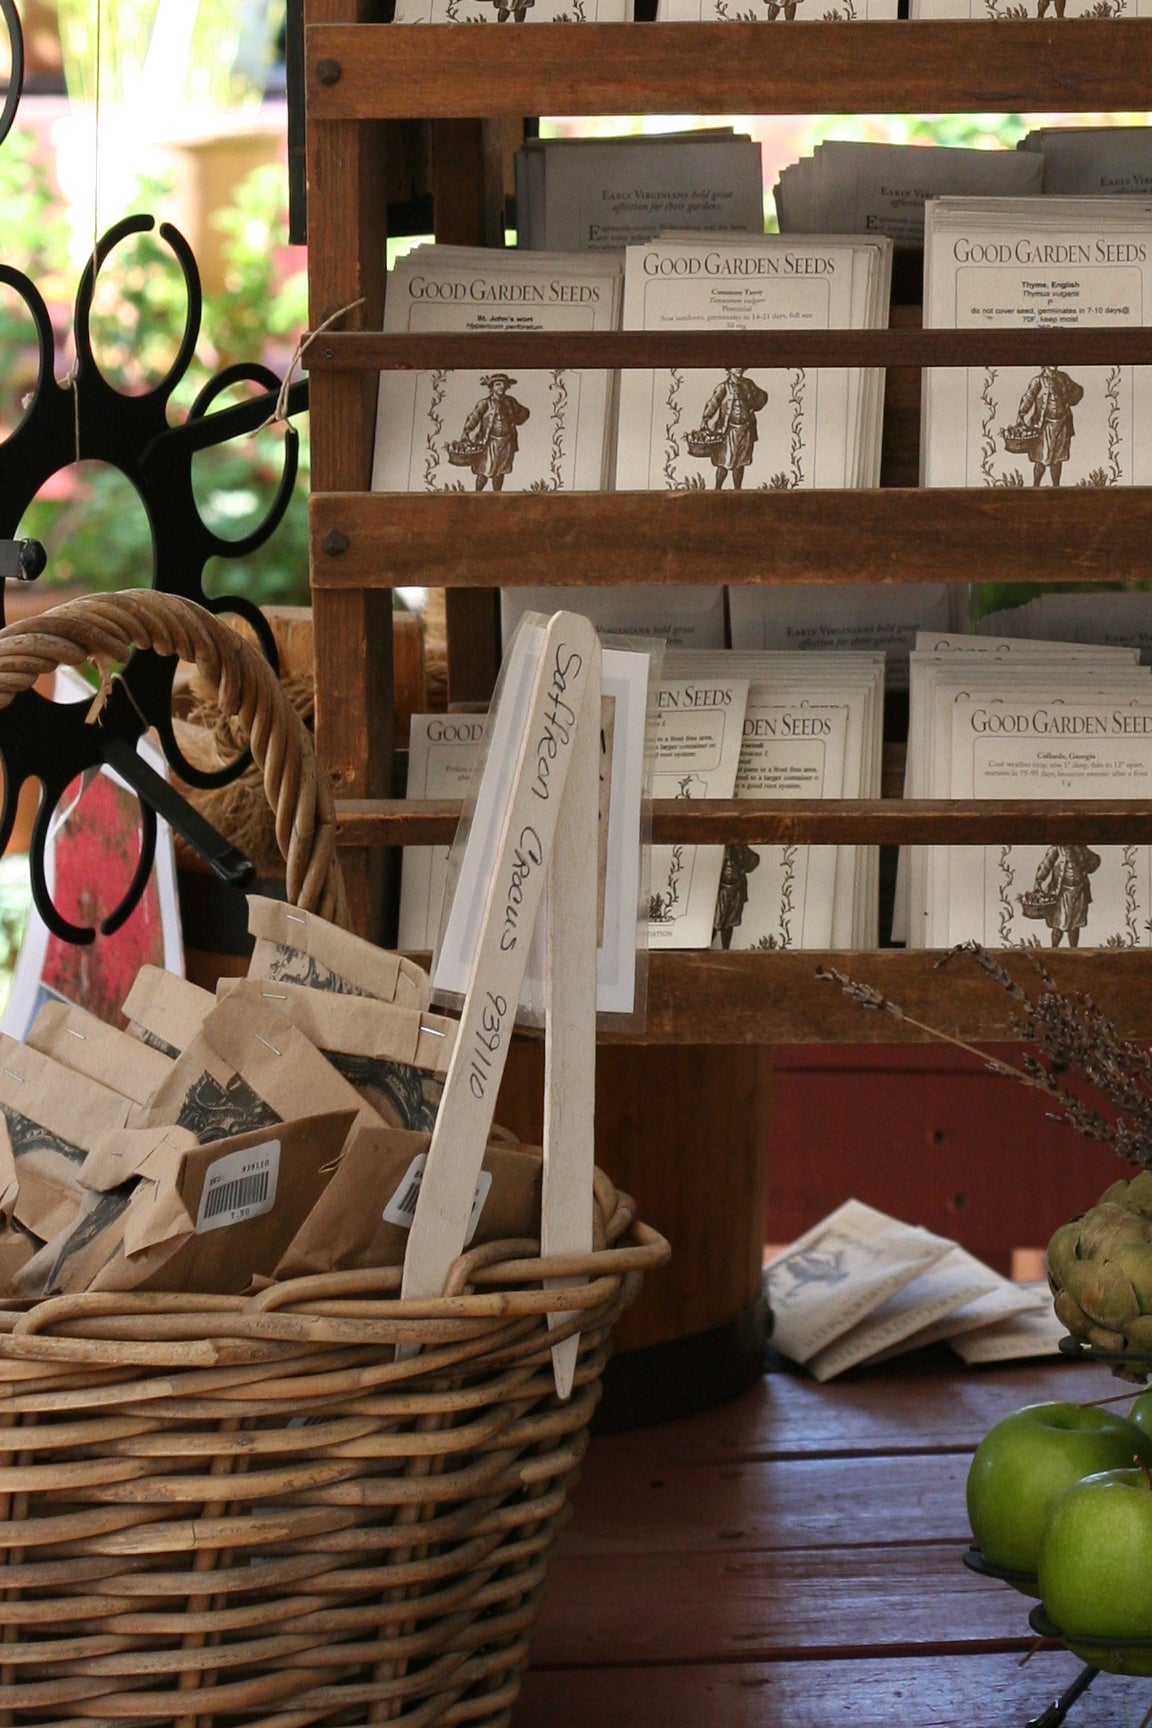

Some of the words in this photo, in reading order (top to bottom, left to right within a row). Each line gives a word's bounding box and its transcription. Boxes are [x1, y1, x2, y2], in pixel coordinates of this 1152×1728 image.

[954, 238, 1012, 263] GOOD
[1015, 239, 1090, 263] GARDEN
[1096, 239, 1146, 262] SEEDS
[643, 252, 700, 276] GOOD
[704, 253, 780, 274] GARDEN
[783, 253, 834, 273] SEEDS
[409, 276, 466, 300] GOOD
[470, 280, 545, 302] GARDEN
[549, 280, 600, 302] SEEDS
[684, 686, 732, 706] SEEDS
[427, 720, 483, 742] GOOD
[781, 714, 832, 737] SEEDS
[971, 710, 1028, 733] GOOD
[1032, 710, 1106, 734] GARDEN
[470, 991, 508, 1099] 939110
